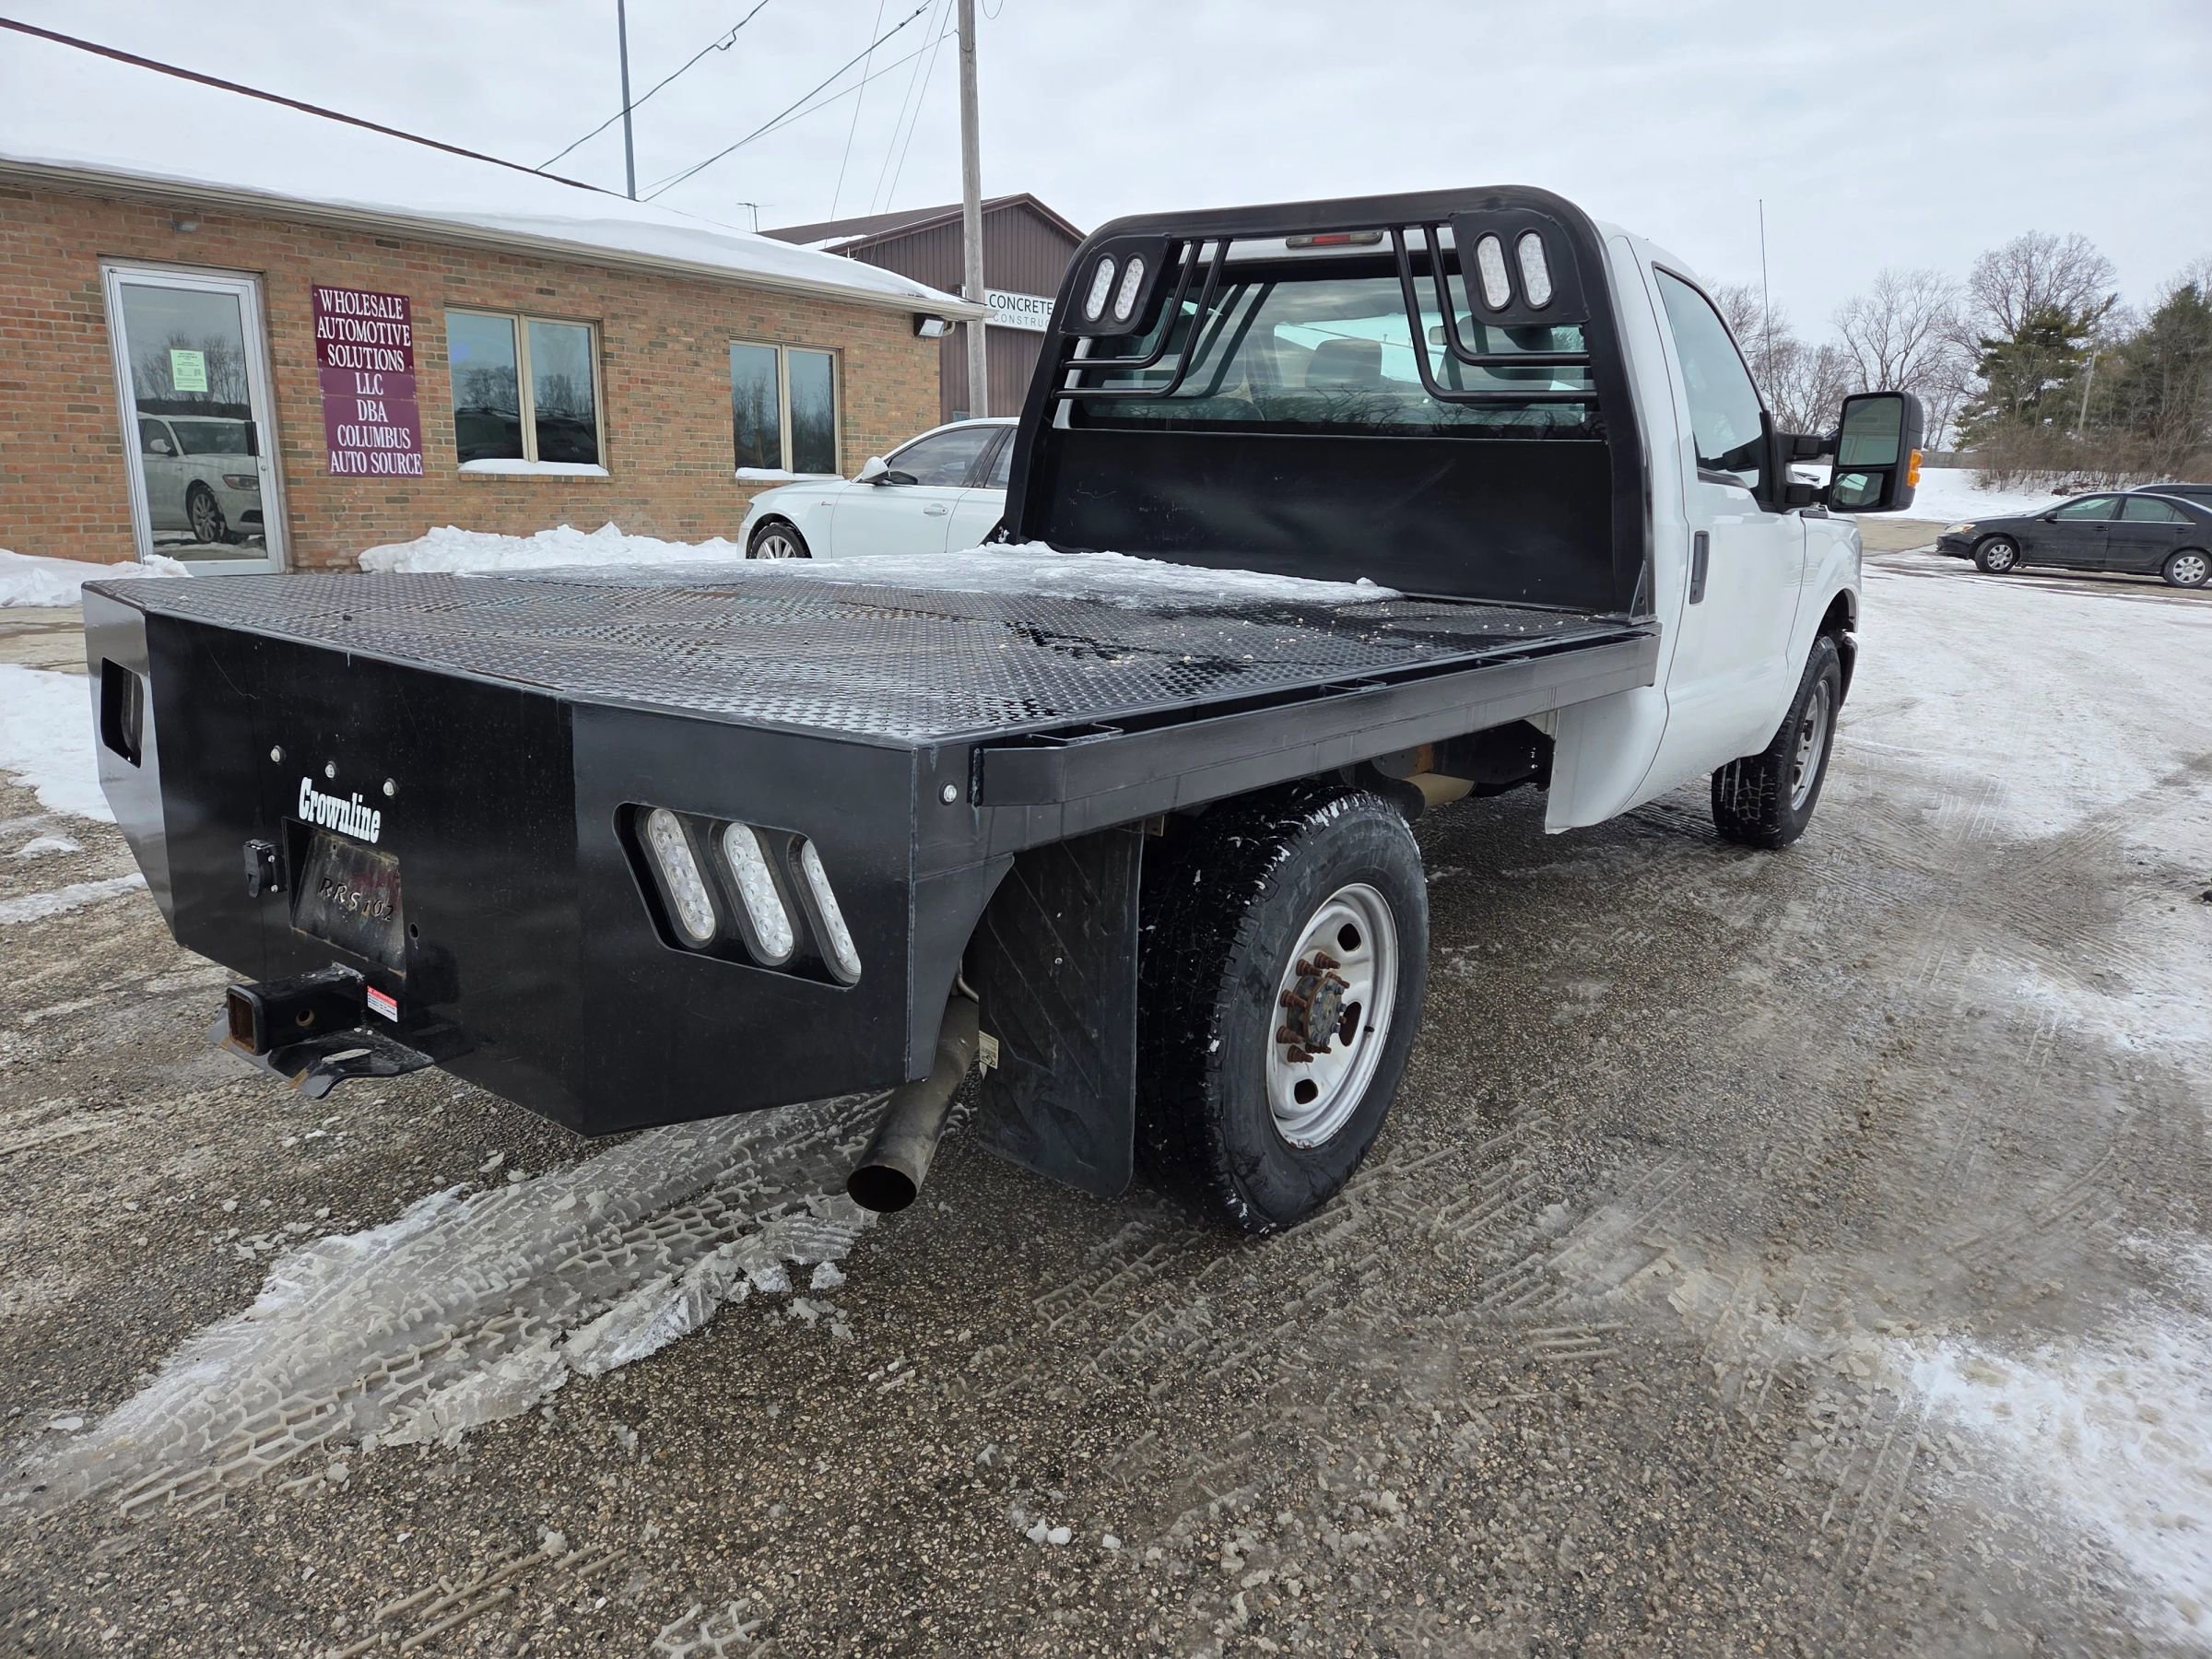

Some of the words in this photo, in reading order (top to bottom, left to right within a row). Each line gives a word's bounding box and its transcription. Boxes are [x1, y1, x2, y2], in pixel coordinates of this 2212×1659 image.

[318, 288, 404, 320] WHOLESALE
[989, 294, 1053, 315] CONCRETE
[317, 315, 411, 347] AUTOMOTIVE
[327, 344, 405, 372] SOLUTIONS
[354, 371, 384, 395] LLC
[357, 399, 389, 423] DBA
[337, 424, 411, 449] COLUMBUS
[330, 451, 368, 474] AUTO
[371, 452, 423, 475] SOURCE
[299, 777, 381, 843] Crownline
